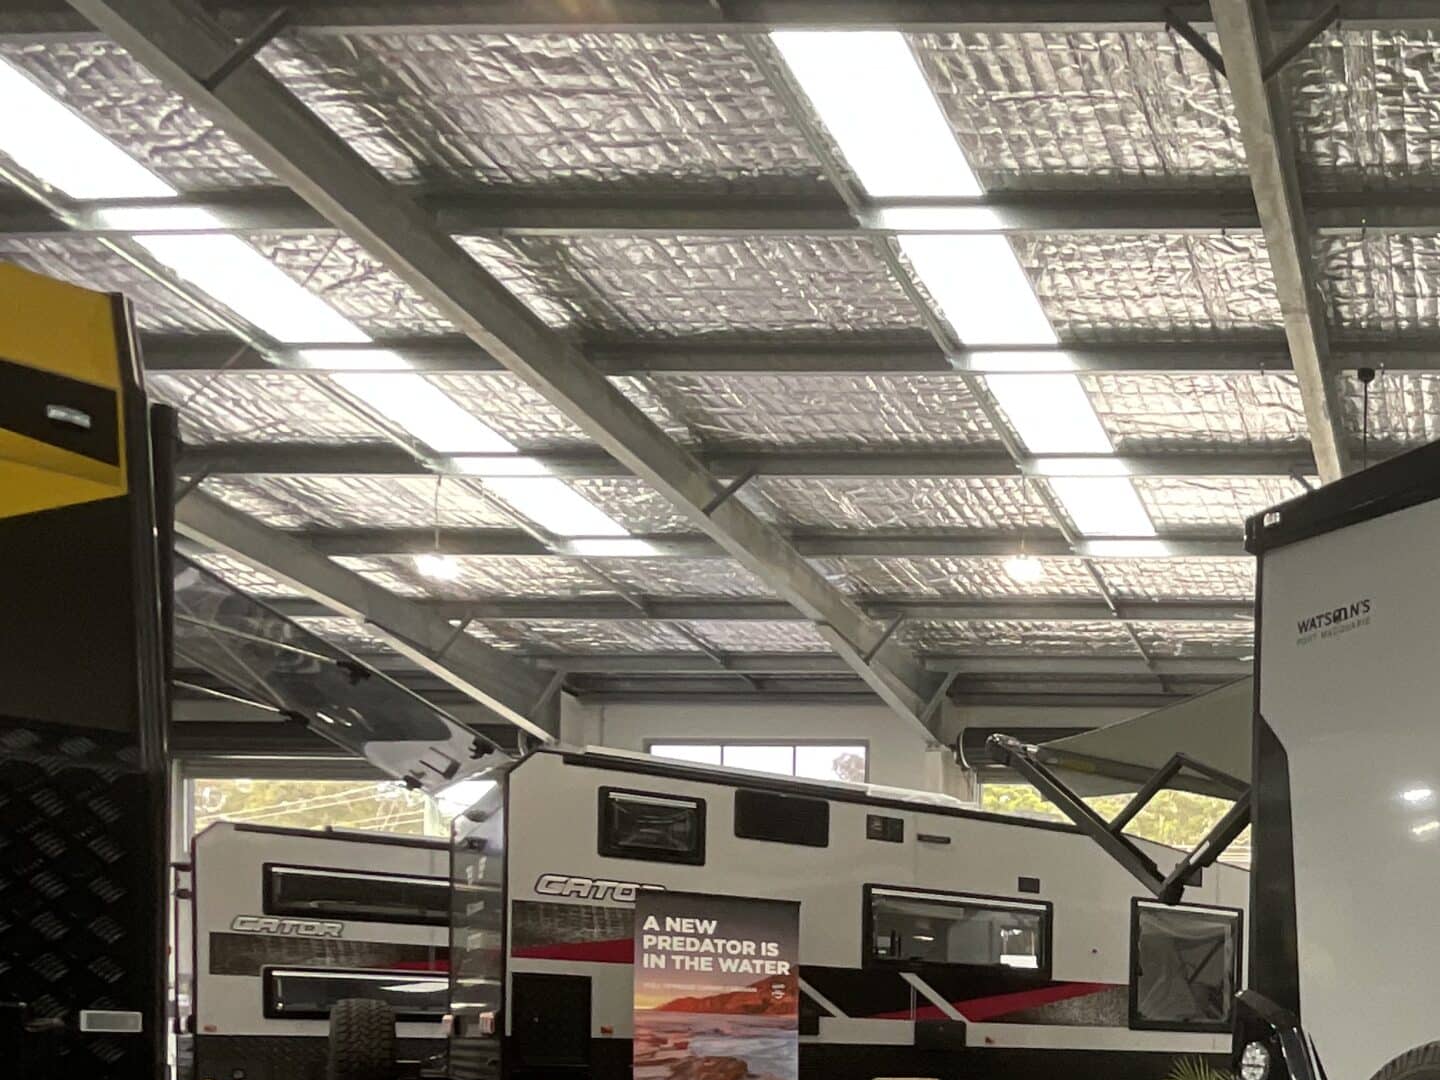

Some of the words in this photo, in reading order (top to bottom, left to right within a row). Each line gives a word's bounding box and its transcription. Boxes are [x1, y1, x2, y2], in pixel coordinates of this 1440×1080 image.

[534, 873, 666, 903] GATO
[643, 915, 660, 931] A
[665, 917, 717, 935] NEW
[642, 934, 756, 956] PREDATOR
[761, 942, 779, 957] IS
[642, 953, 665, 969] IN
[671, 955, 713, 972] THE
[718, 958, 791, 975] WATER
